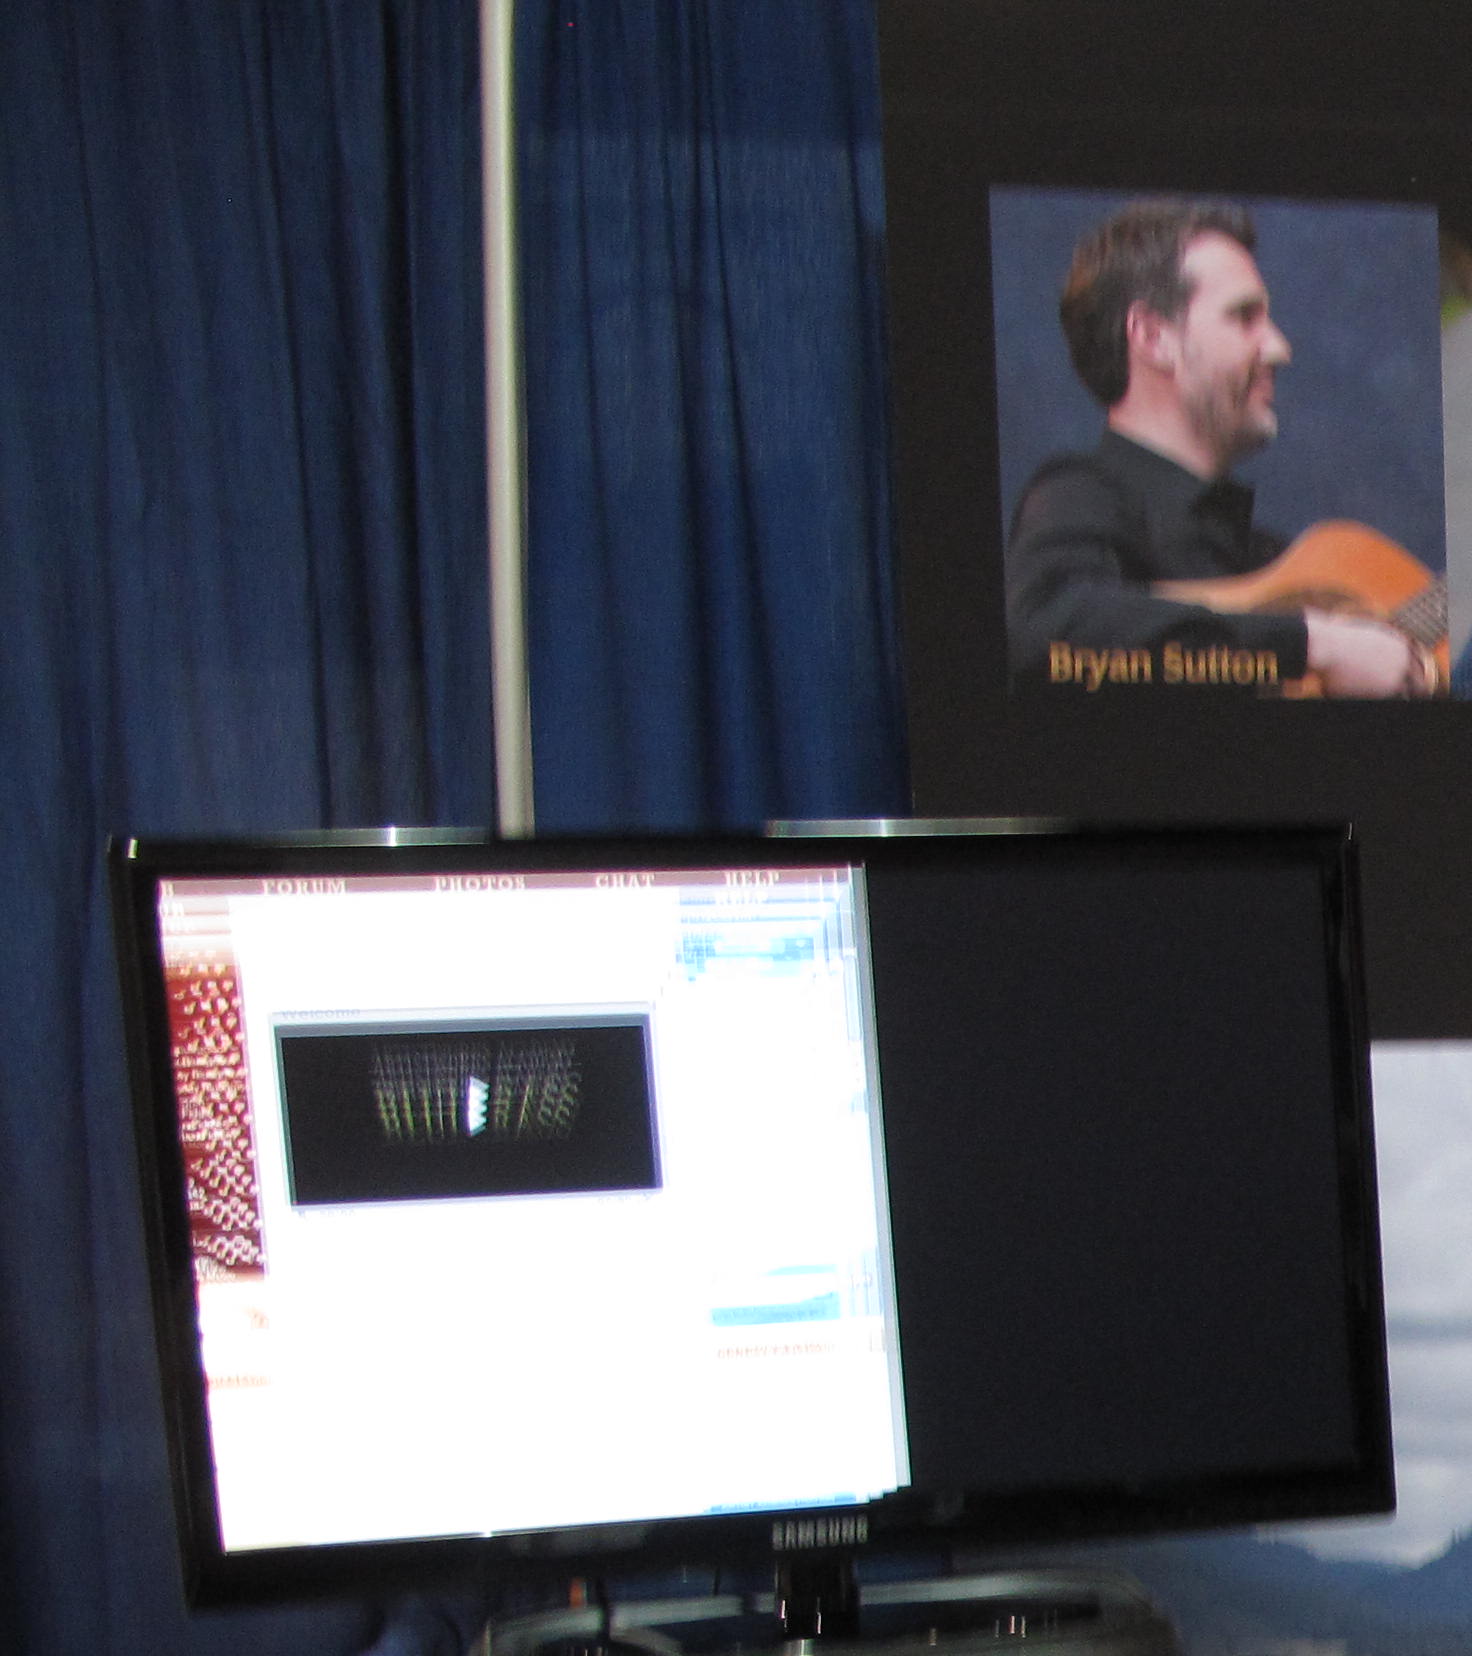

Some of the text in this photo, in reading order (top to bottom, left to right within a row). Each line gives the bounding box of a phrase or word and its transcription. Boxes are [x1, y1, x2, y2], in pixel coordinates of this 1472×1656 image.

[1049, 640, 1279, 693] Bryan Sutton
[262, 869, 781, 897] FORUM PHOTOS CHAT HELP
